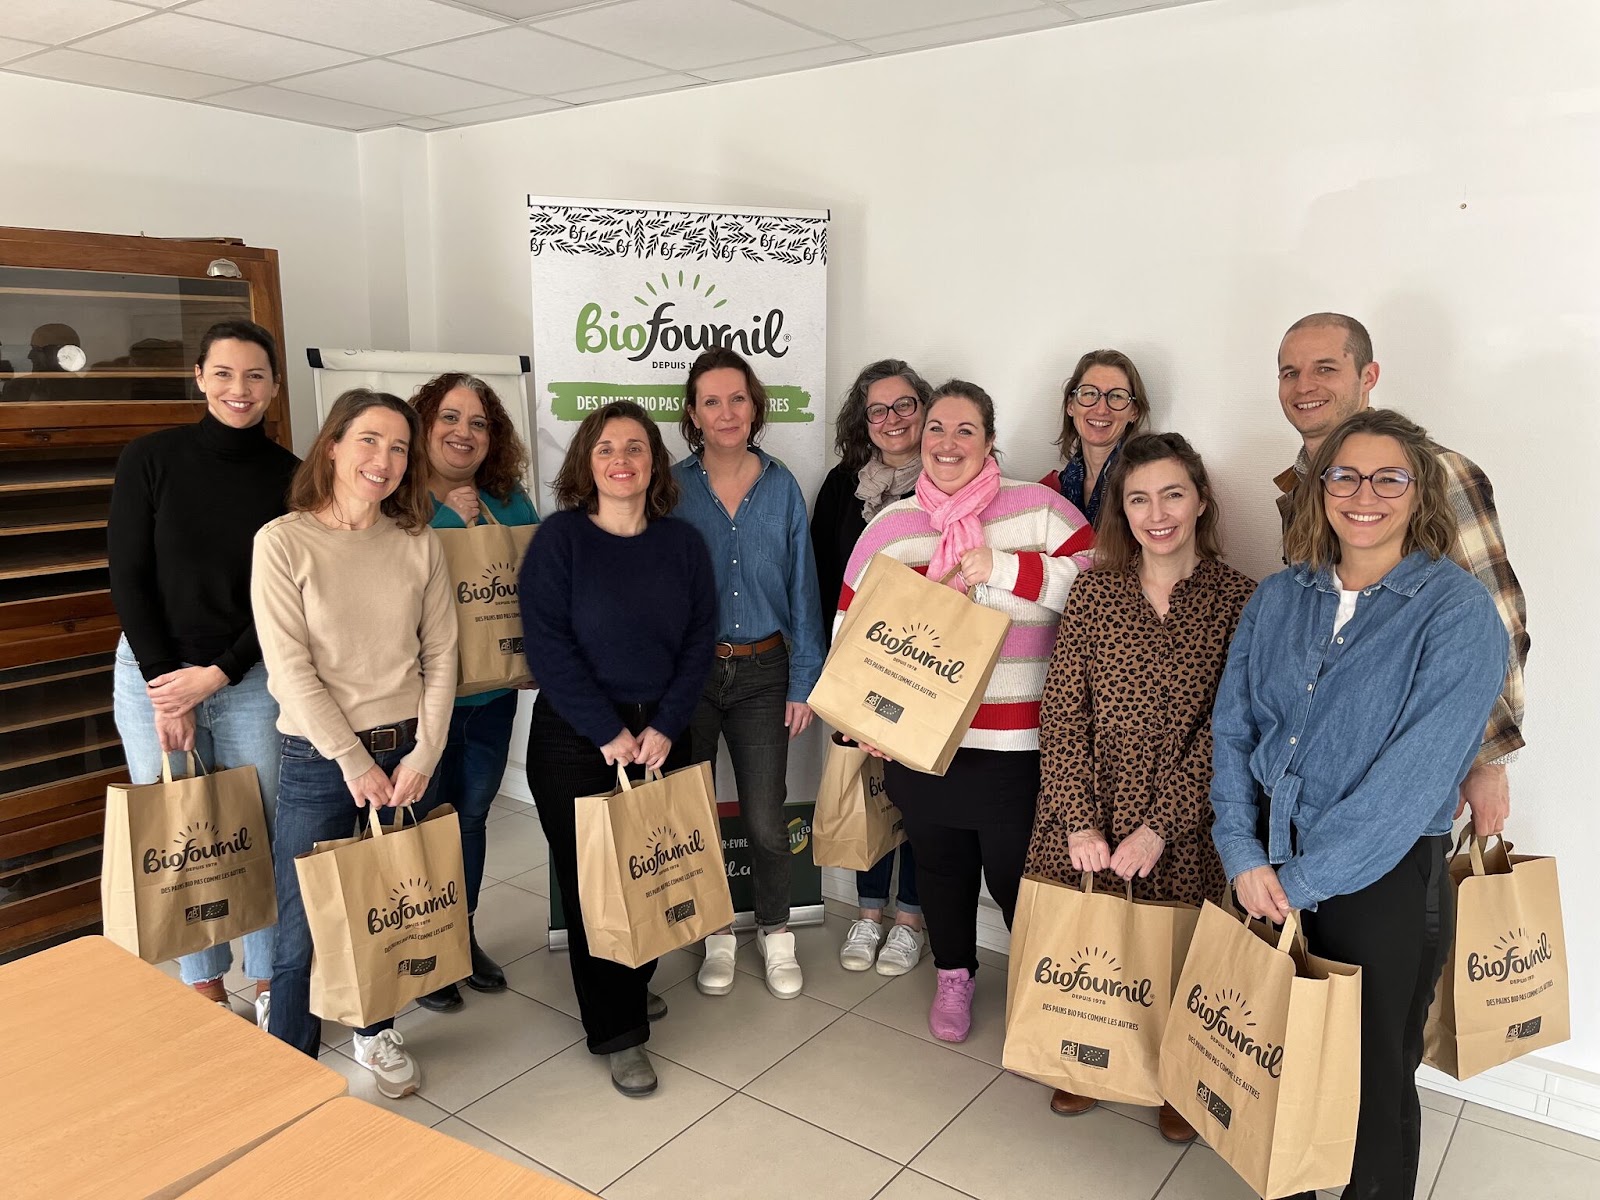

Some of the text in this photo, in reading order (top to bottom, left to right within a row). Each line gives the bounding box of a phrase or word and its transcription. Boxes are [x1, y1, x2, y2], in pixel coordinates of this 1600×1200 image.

[652, 361, 686, 370] DEPUIS
[576, 395, 599, 411] DES
[659, 397, 680, 411] PAS
[1071, 993, 1092, 1002] DEPUIS
[1042, 1003, 1139, 1031] DES PAINS BIO PAS COMME LES AUTRES
